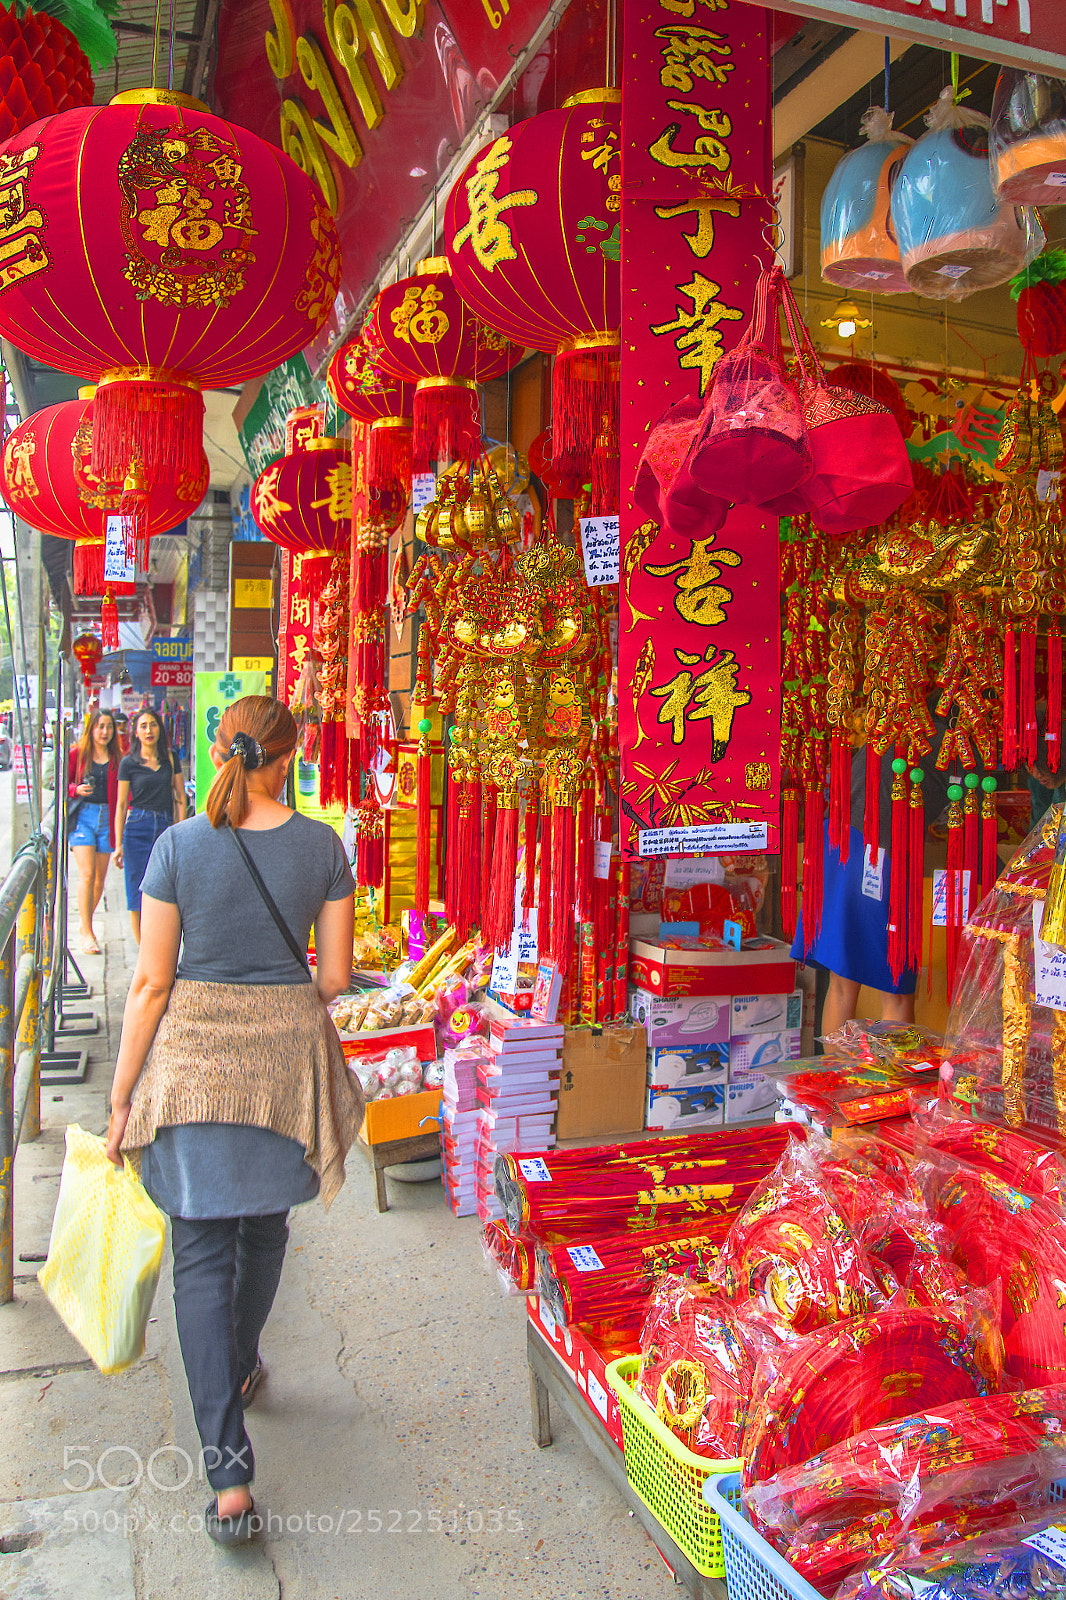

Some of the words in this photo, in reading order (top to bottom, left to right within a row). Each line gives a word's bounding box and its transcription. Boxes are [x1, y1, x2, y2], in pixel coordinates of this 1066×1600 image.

[154, 671, 193, 683] 20-80
[734, 996, 759, 1004] PHILIPS
[728, 1083, 754, 1092] PHILIPS
